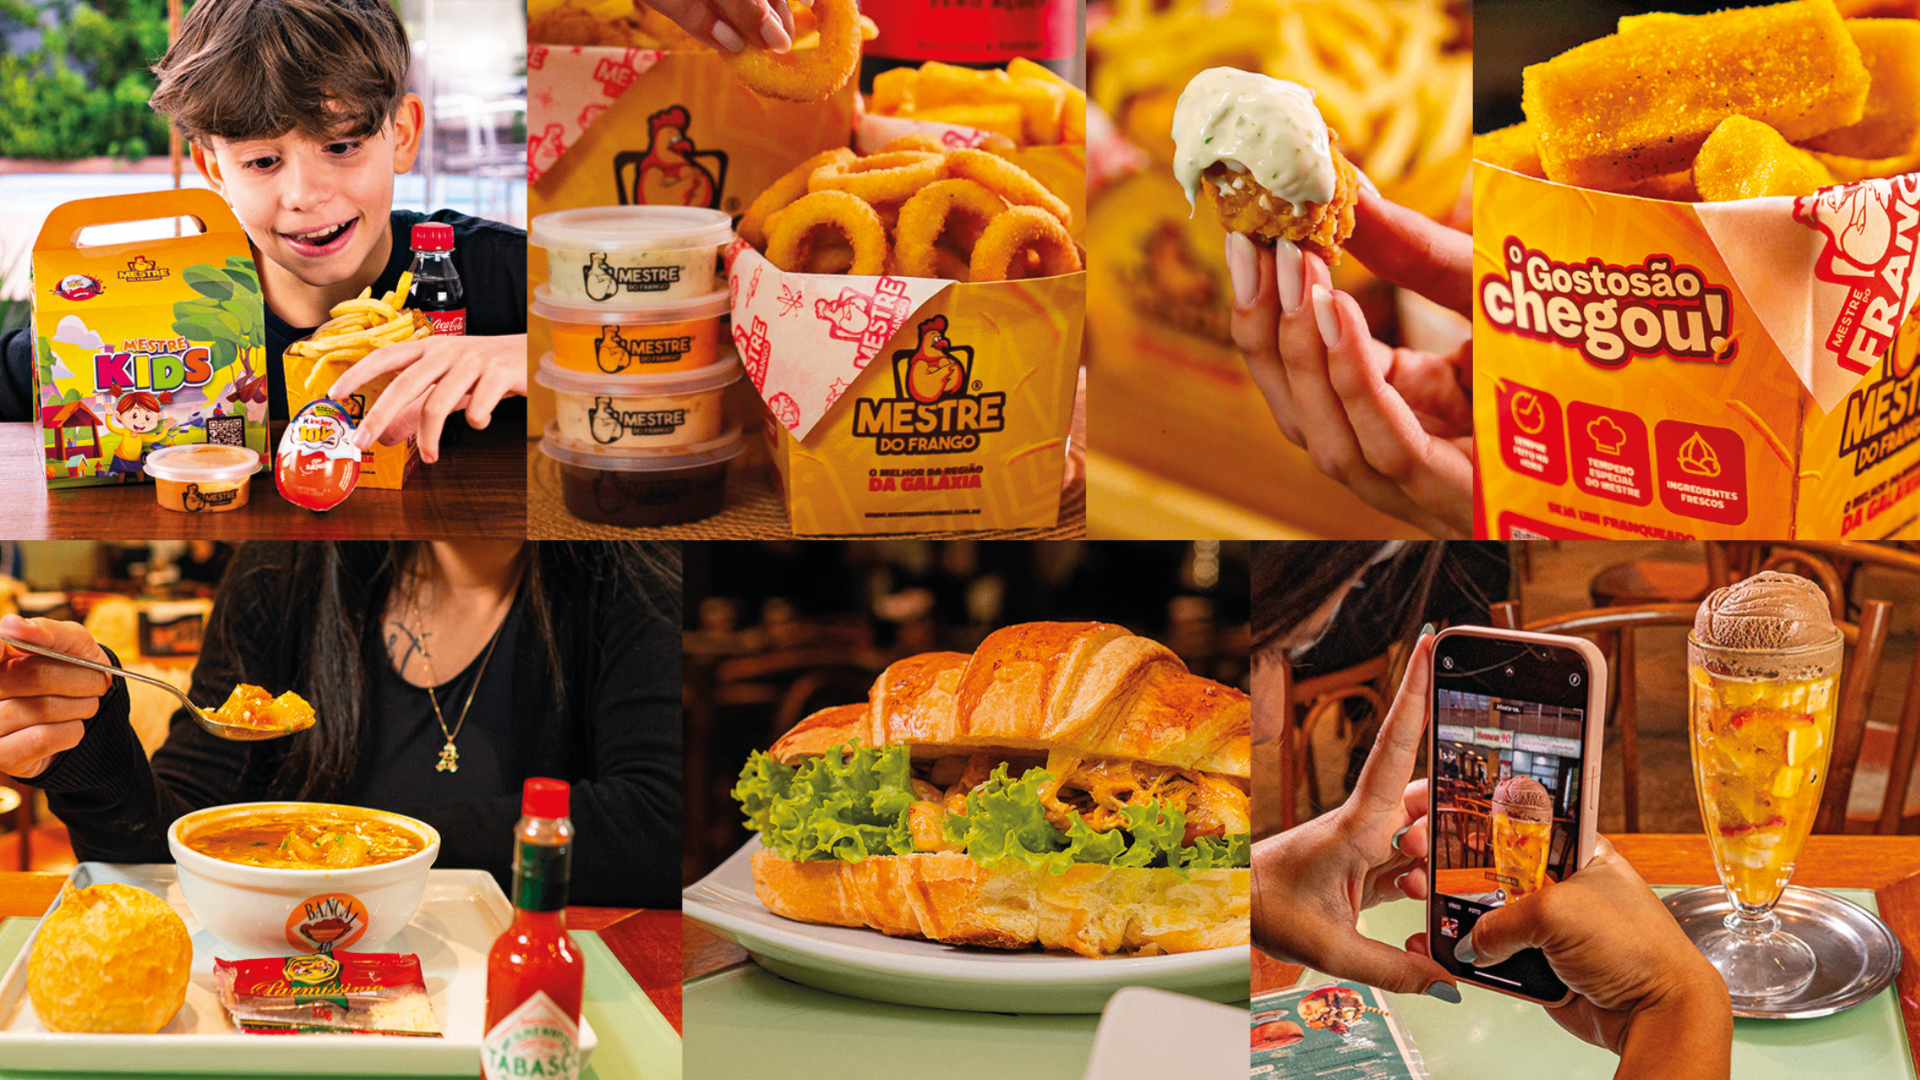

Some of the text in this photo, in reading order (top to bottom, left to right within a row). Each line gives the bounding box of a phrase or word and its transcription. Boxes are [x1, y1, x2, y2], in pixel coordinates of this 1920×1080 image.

[118, 268, 169, 279] MESTRE
[619, 267, 679, 283] MESTRE
[1526, 256, 1701, 298] Gostosão
[1861, 288, 1872, 303] DO
[1483, 270, 1728, 360] chegou!
[1831, 288, 1864, 348] MESTRE
[122, 335, 188, 353] MESTRE
[631, 338, 689, 355] MESTRE
[95, 347, 213, 391] KIDS
[623, 410, 684, 427] MESTRE
[856, 396, 1002, 435] MESTRE
[1841, 368, 1920, 451] MEST
[303, 417, 333, 427] Kinder
[880, 435, 977, 452] DO FRANGO
[1857, 440, 1879, 470] DO
[868, 468, 878, 477] O
[879, 468, 924, 477] MELHOR
[1587, 457, 1635, 476] TEMPERO
[868, 472, 982, 492] DA GALÁXIA
[1585, 476, 1641, 498] DO MESTRE
[1588, 467, 1635, 487] ESPECIAL
[1666, 480, 1738, 501] INGREDIENTES
[1681, 493, 1725, 509] FRESCOS
[1547, 502, 1696, 540] SEJA UM FRANQUEADO
[304, 898, 353, 921] BANCA
[312, 1006, 333, 1022] 10g
